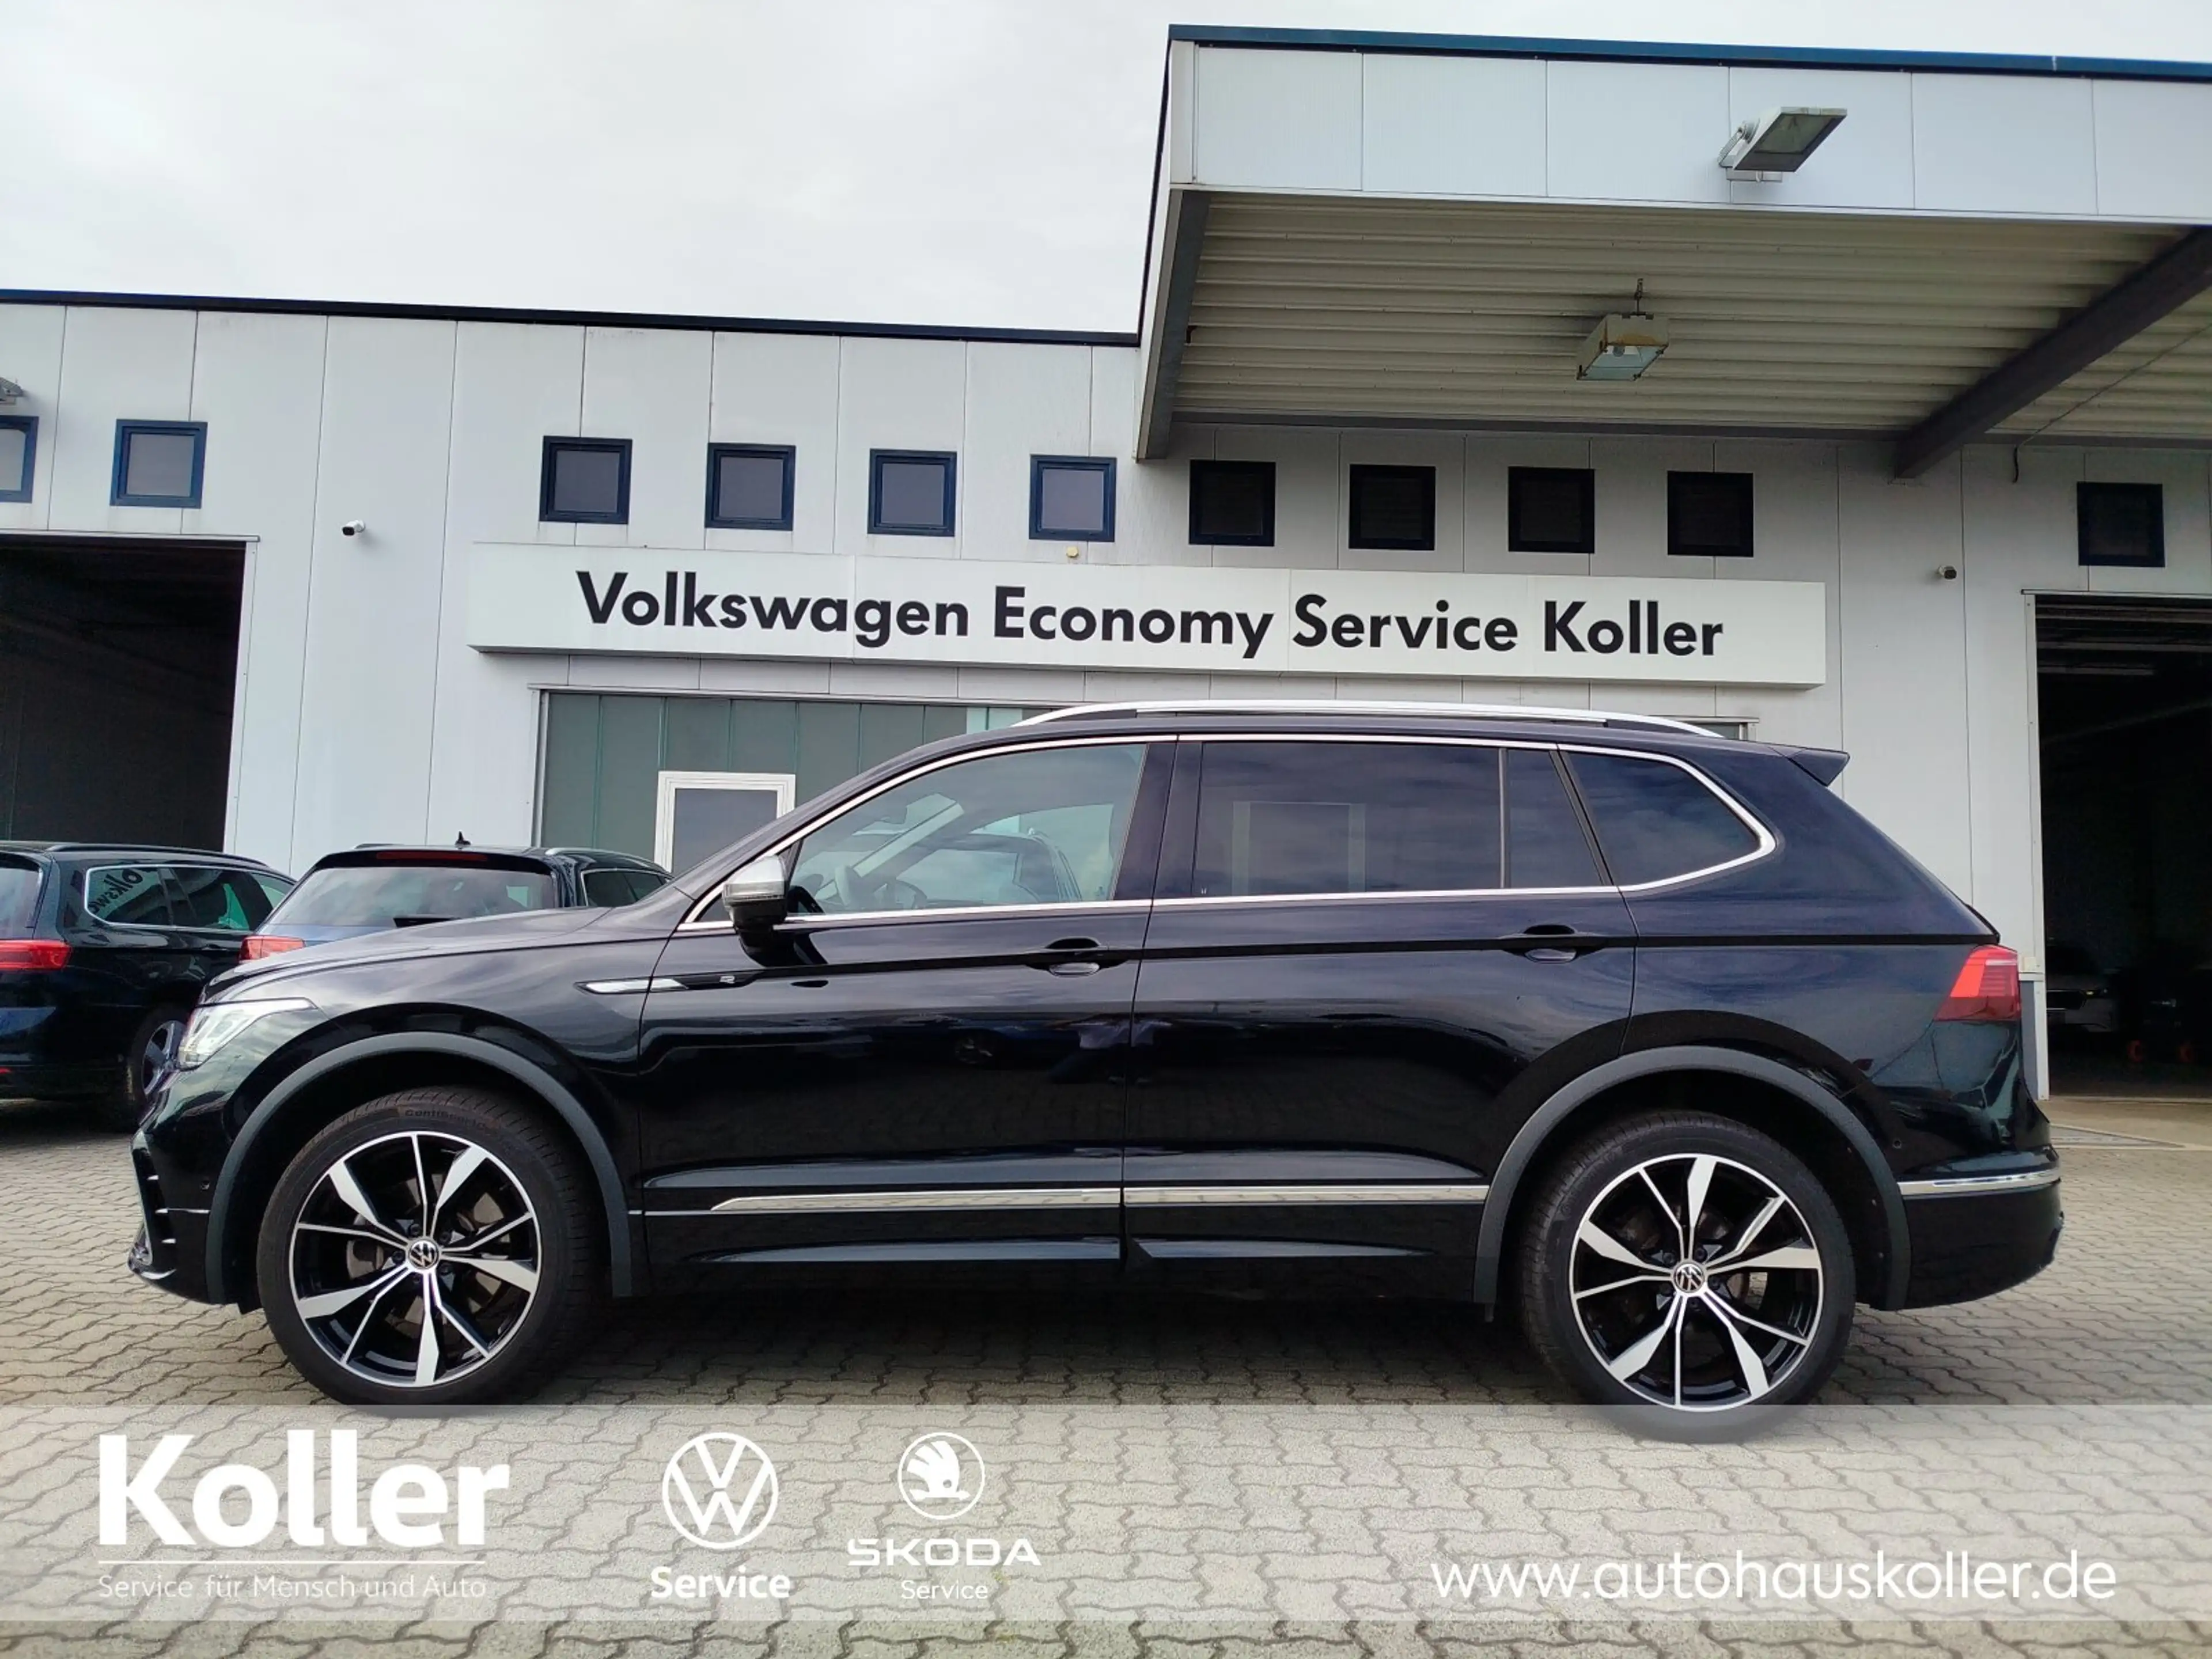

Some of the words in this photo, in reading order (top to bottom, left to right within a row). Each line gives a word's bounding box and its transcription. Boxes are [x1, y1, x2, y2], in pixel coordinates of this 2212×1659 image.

[576, 570, 969, 648] Volkswagen
[994, 586, 1274, 659] Economy
[1293, 593, 1518, 652] Service
[1544, 600, 1723, 656] Koller
